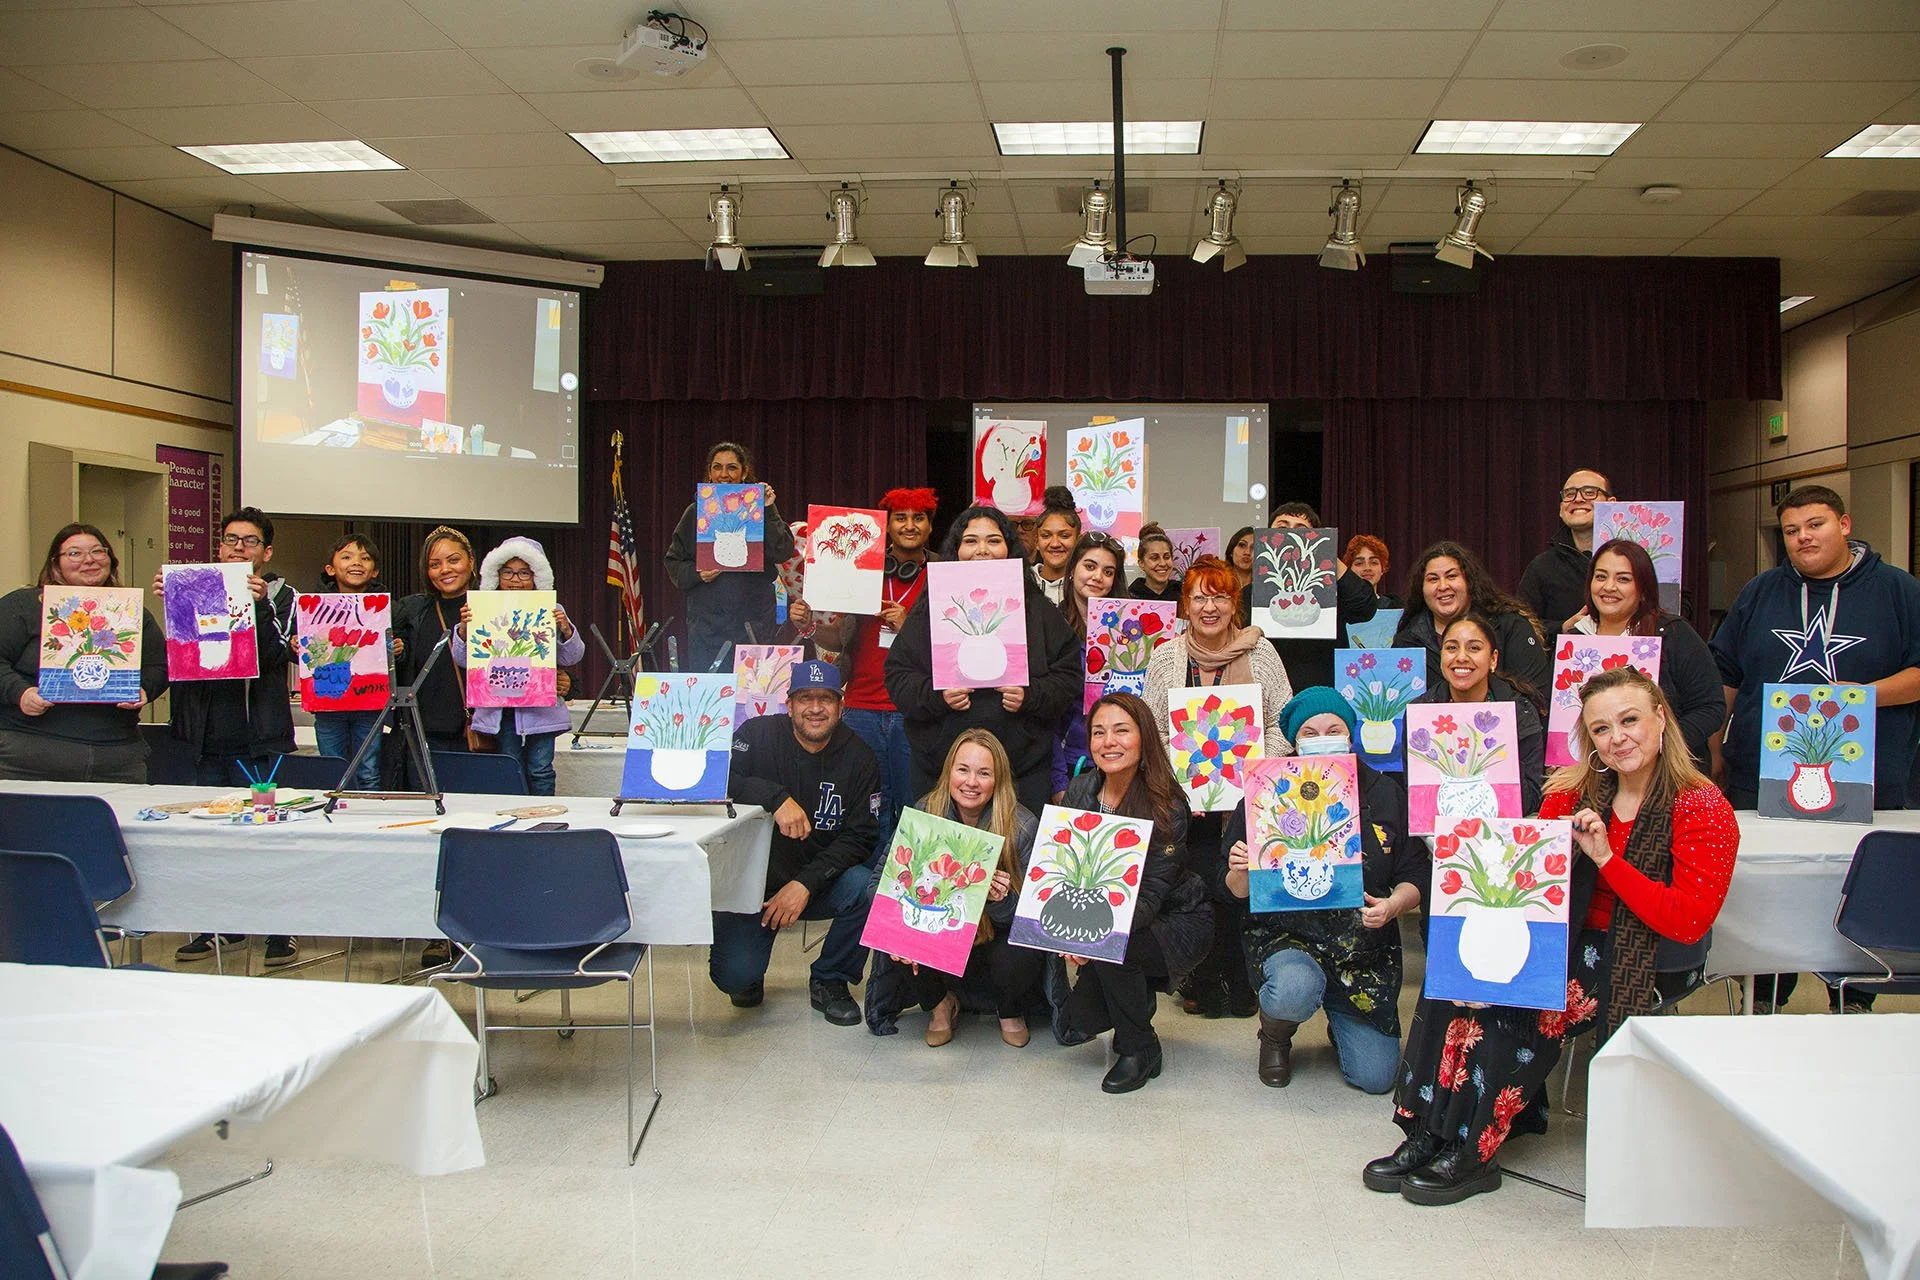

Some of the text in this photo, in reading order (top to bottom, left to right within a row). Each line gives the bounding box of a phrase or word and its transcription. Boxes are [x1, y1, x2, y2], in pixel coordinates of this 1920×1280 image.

[169, 461, 195, 474] Person
[169, 475, 205, 489] haracter
[171, 505, 177, 515] is
[184, 508, 201, 517] good
[169, 523, 204, 534] tizen, does
[183, 541, 194, 550] her
[809, 663, 824, 682] LA
[814, 781, 846, 831] LA
